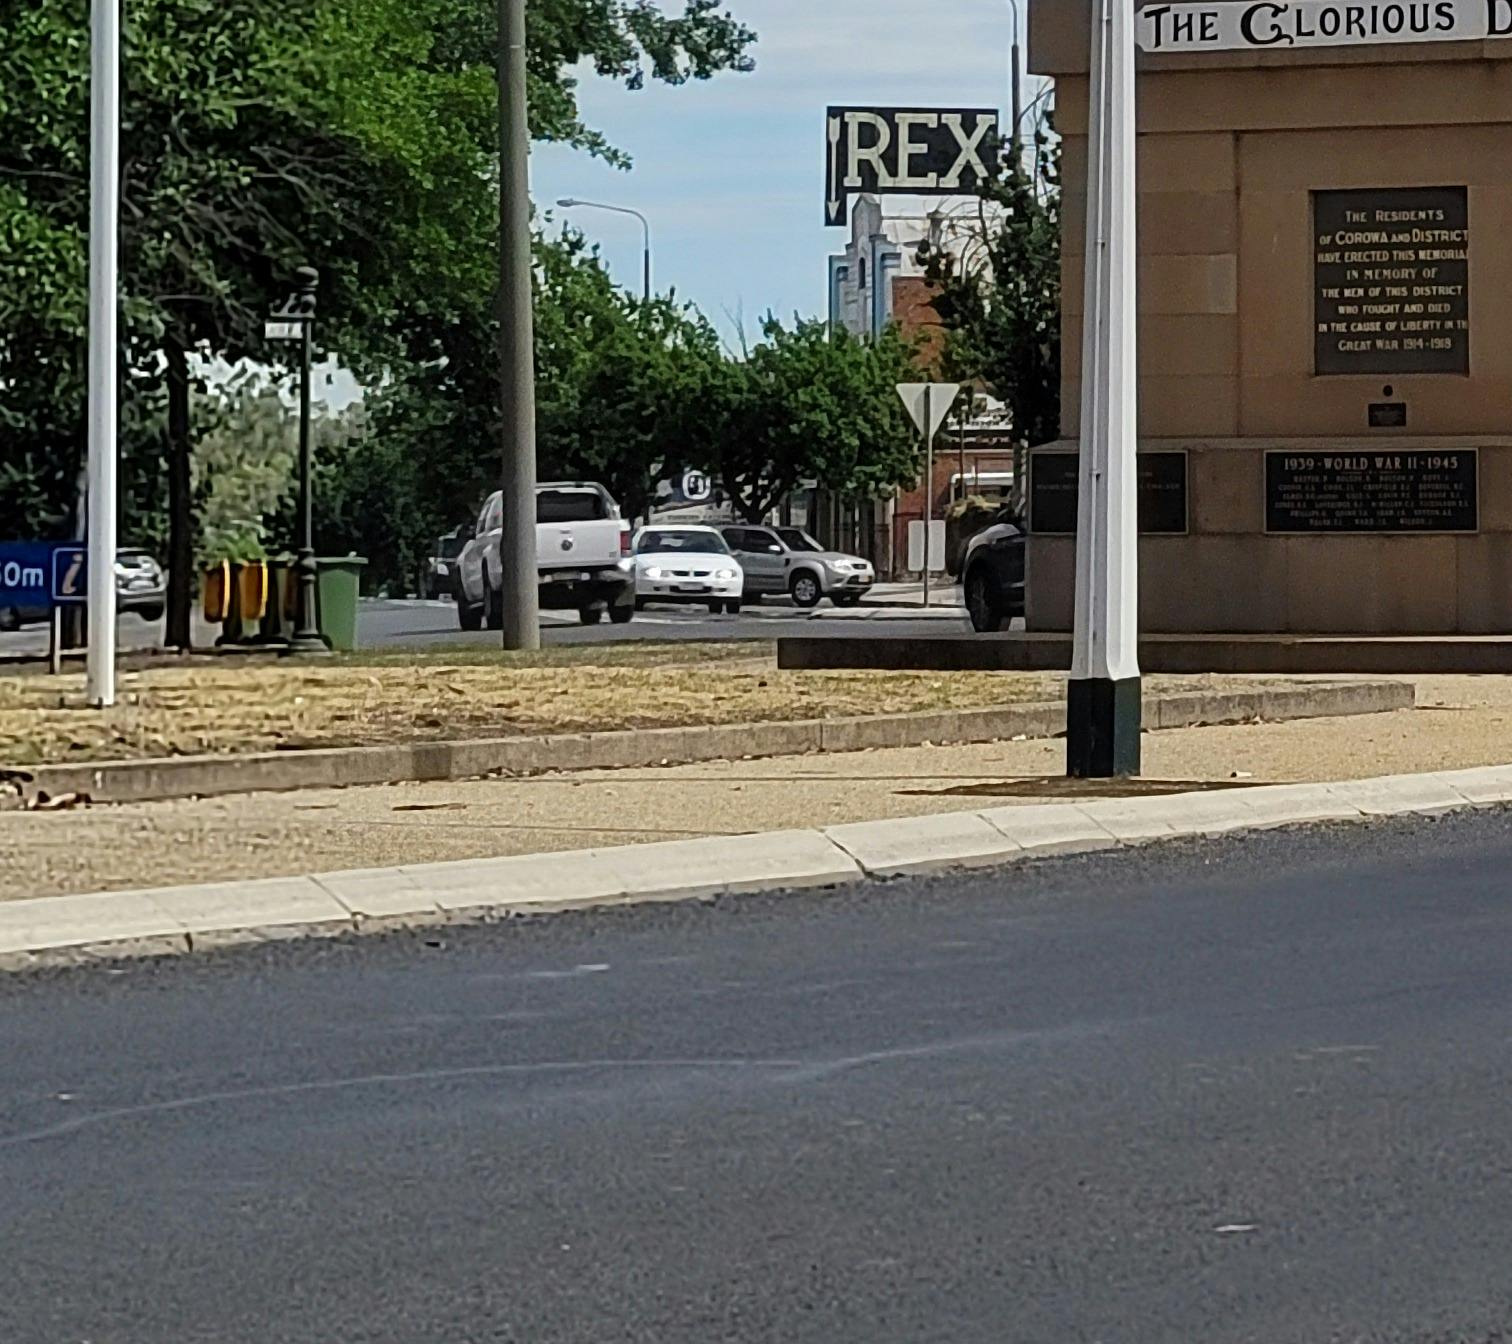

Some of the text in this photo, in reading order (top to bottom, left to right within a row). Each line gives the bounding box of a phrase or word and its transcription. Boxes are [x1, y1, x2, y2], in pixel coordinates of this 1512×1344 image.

[1144, 5, 1218, 48] THE
[1240, 1, 1455, 45] GLORIOUS
[843, 112, 996, 187] REX
[1345, 209, 1445, 223] THE RESIDENTS
[1319, 227, 1468, 246] OF COROWA AND DISTRICT
[1344, 250, 1389, 262] ERECTED
[1392, 250, 1415, 261] THIS
[1346, 267, 1438, 280] IN MEMORY OF
[1322, 285, 1463, 298] THE MEN OF THIS DISTRICT
[1338, 302, 1451, 314] WHO FOUGHT AND DIED
[1318, 322, 1328, 333] IN
[1330, 321, 1347, 333] THE
[1350, 321, 1381, 332] CAUSE
[1385, 320, 1397, 331] OF
[1400, 319, 1441, 331] LIBERTY
[1444, 320, 1453, 330] IN
[1338, 339, 1371, 351] GREAT
[1375, 338, 1399, 350] WAR
[1374, 456, 1401, 470] WAR
[0, 561, 44, 587] 0m
